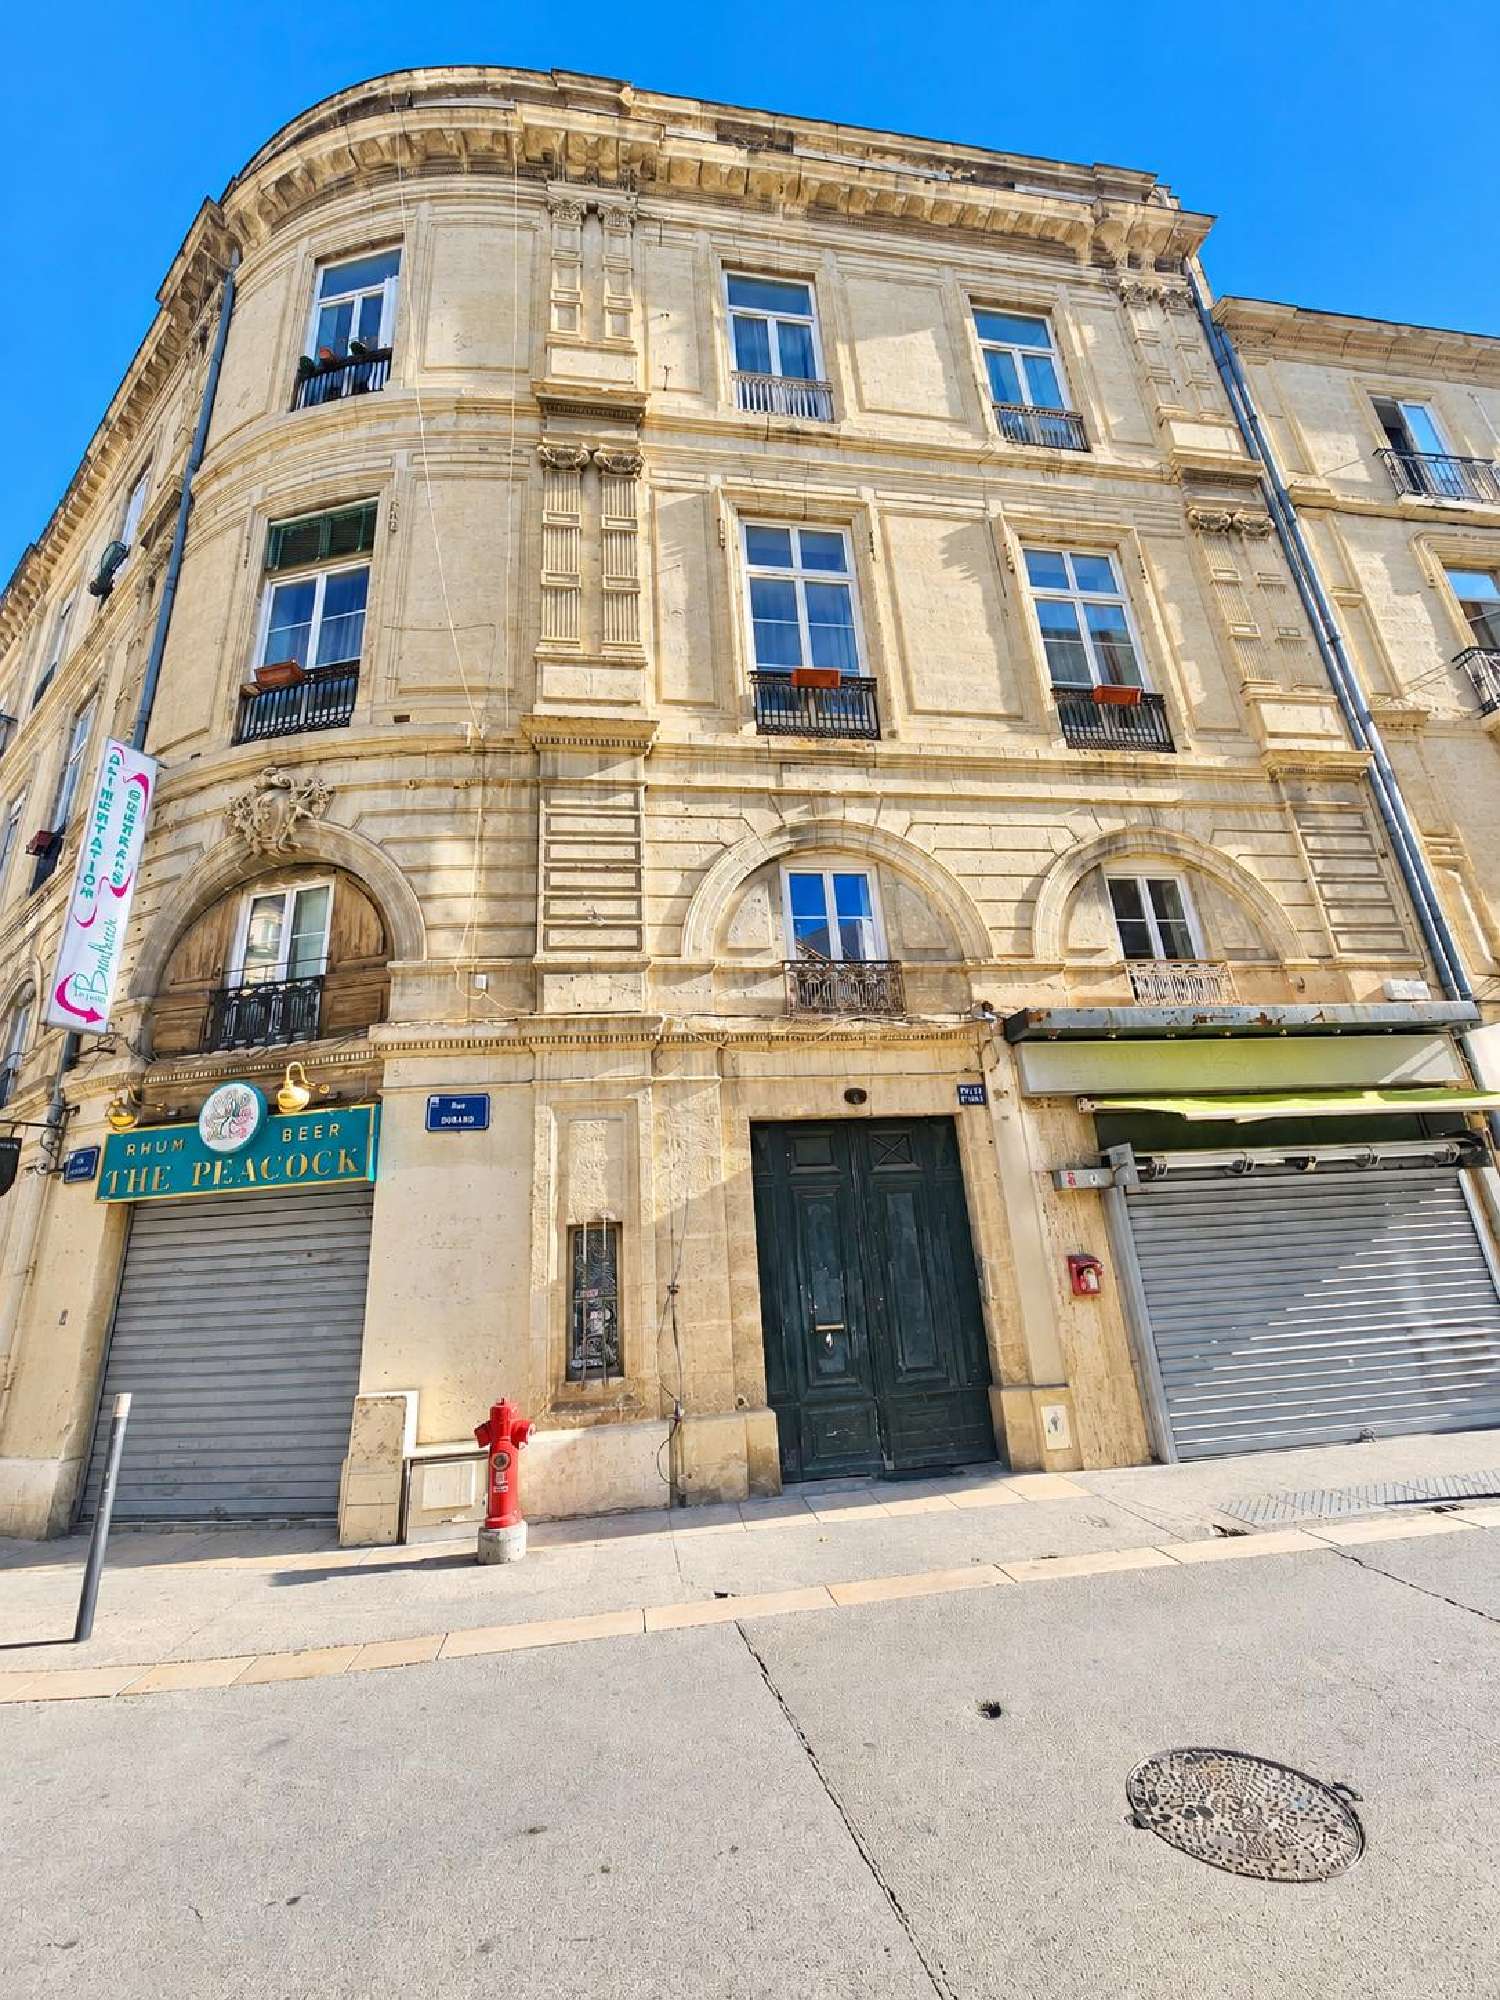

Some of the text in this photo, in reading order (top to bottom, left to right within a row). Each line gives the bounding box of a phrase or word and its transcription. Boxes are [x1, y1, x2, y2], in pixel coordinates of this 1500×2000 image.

[126, 1123, 340, 1156] RHUM BEER
[106, 1147, 358, 1194] THE PEACOCK
